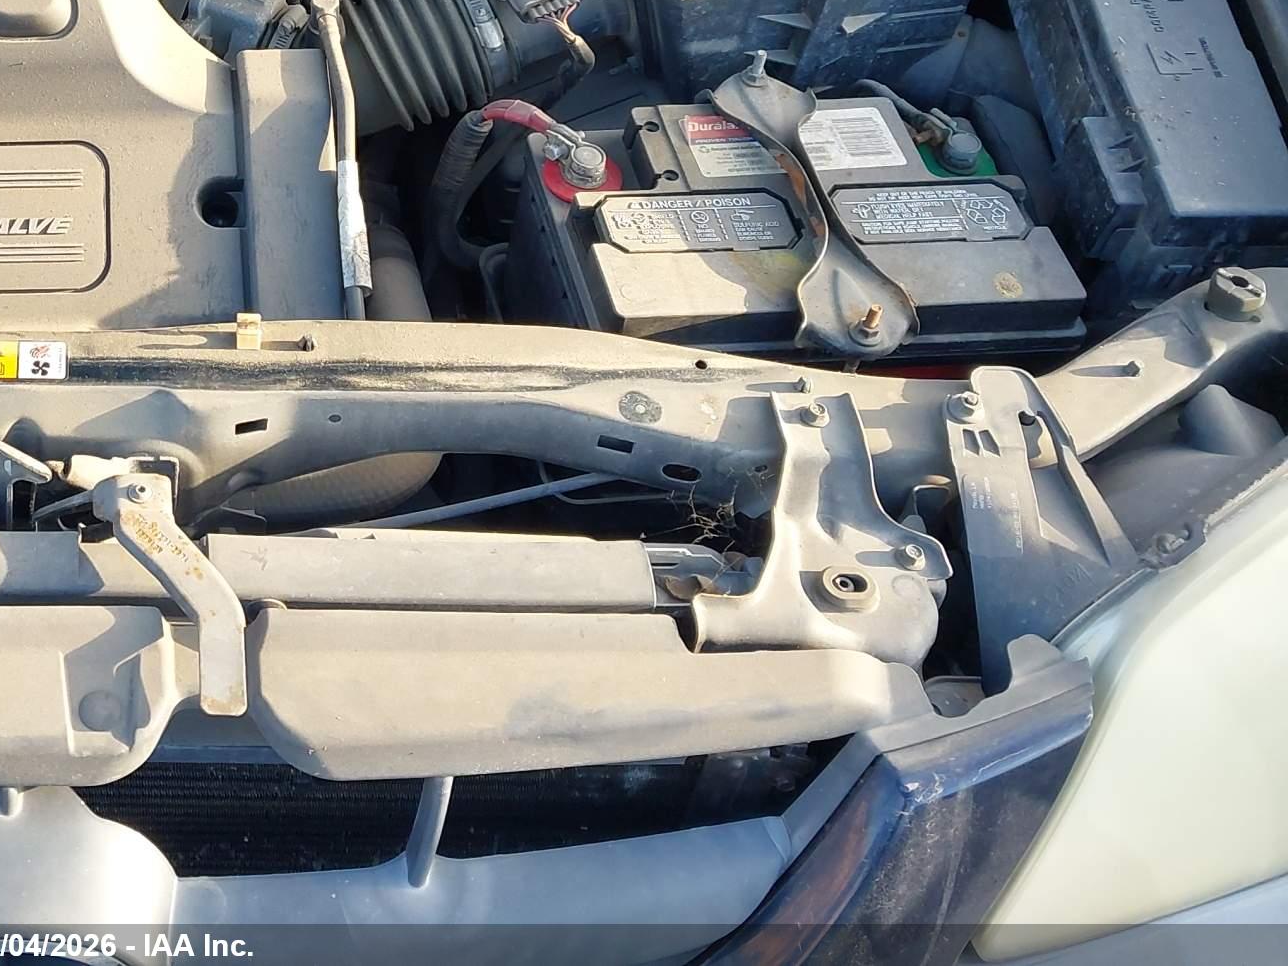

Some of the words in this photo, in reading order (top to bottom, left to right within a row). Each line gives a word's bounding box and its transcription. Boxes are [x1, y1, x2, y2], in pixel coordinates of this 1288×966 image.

[688, 120, 740, 132] Durala
[642, 199, 693, 209] DANGER
[704, 197, 752, 207] POISON
